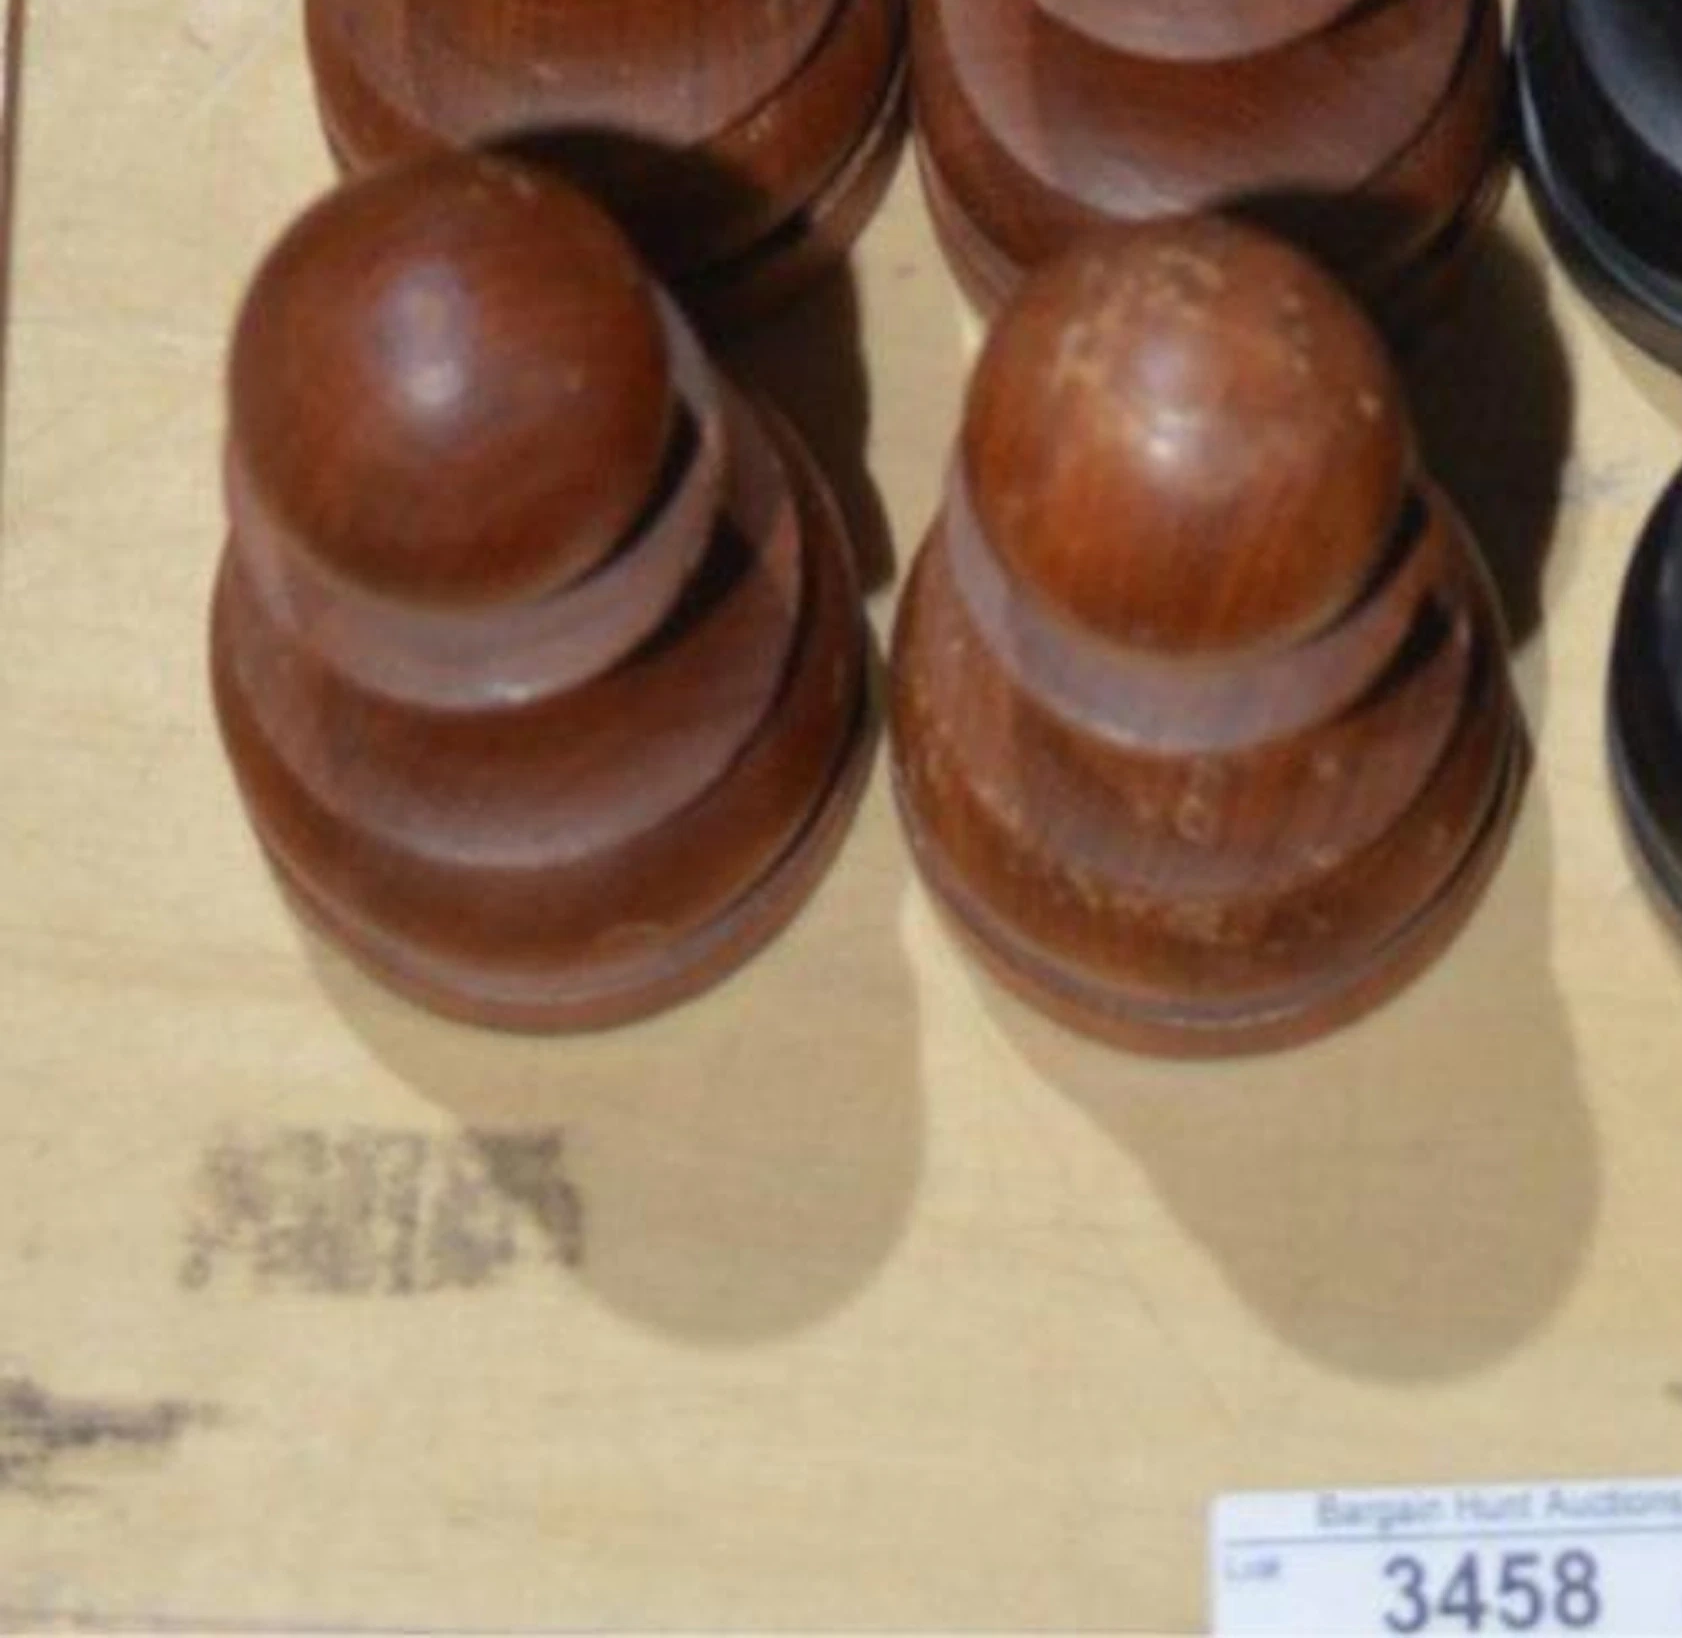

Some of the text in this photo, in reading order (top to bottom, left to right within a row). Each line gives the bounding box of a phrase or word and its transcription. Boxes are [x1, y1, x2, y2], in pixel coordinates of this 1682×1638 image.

[1316, 1493, 1441, 1530] Bargain
[1454, 1489, 1532, 1520] Hunt
[1382, 1549, 1602, 1634] 3458
